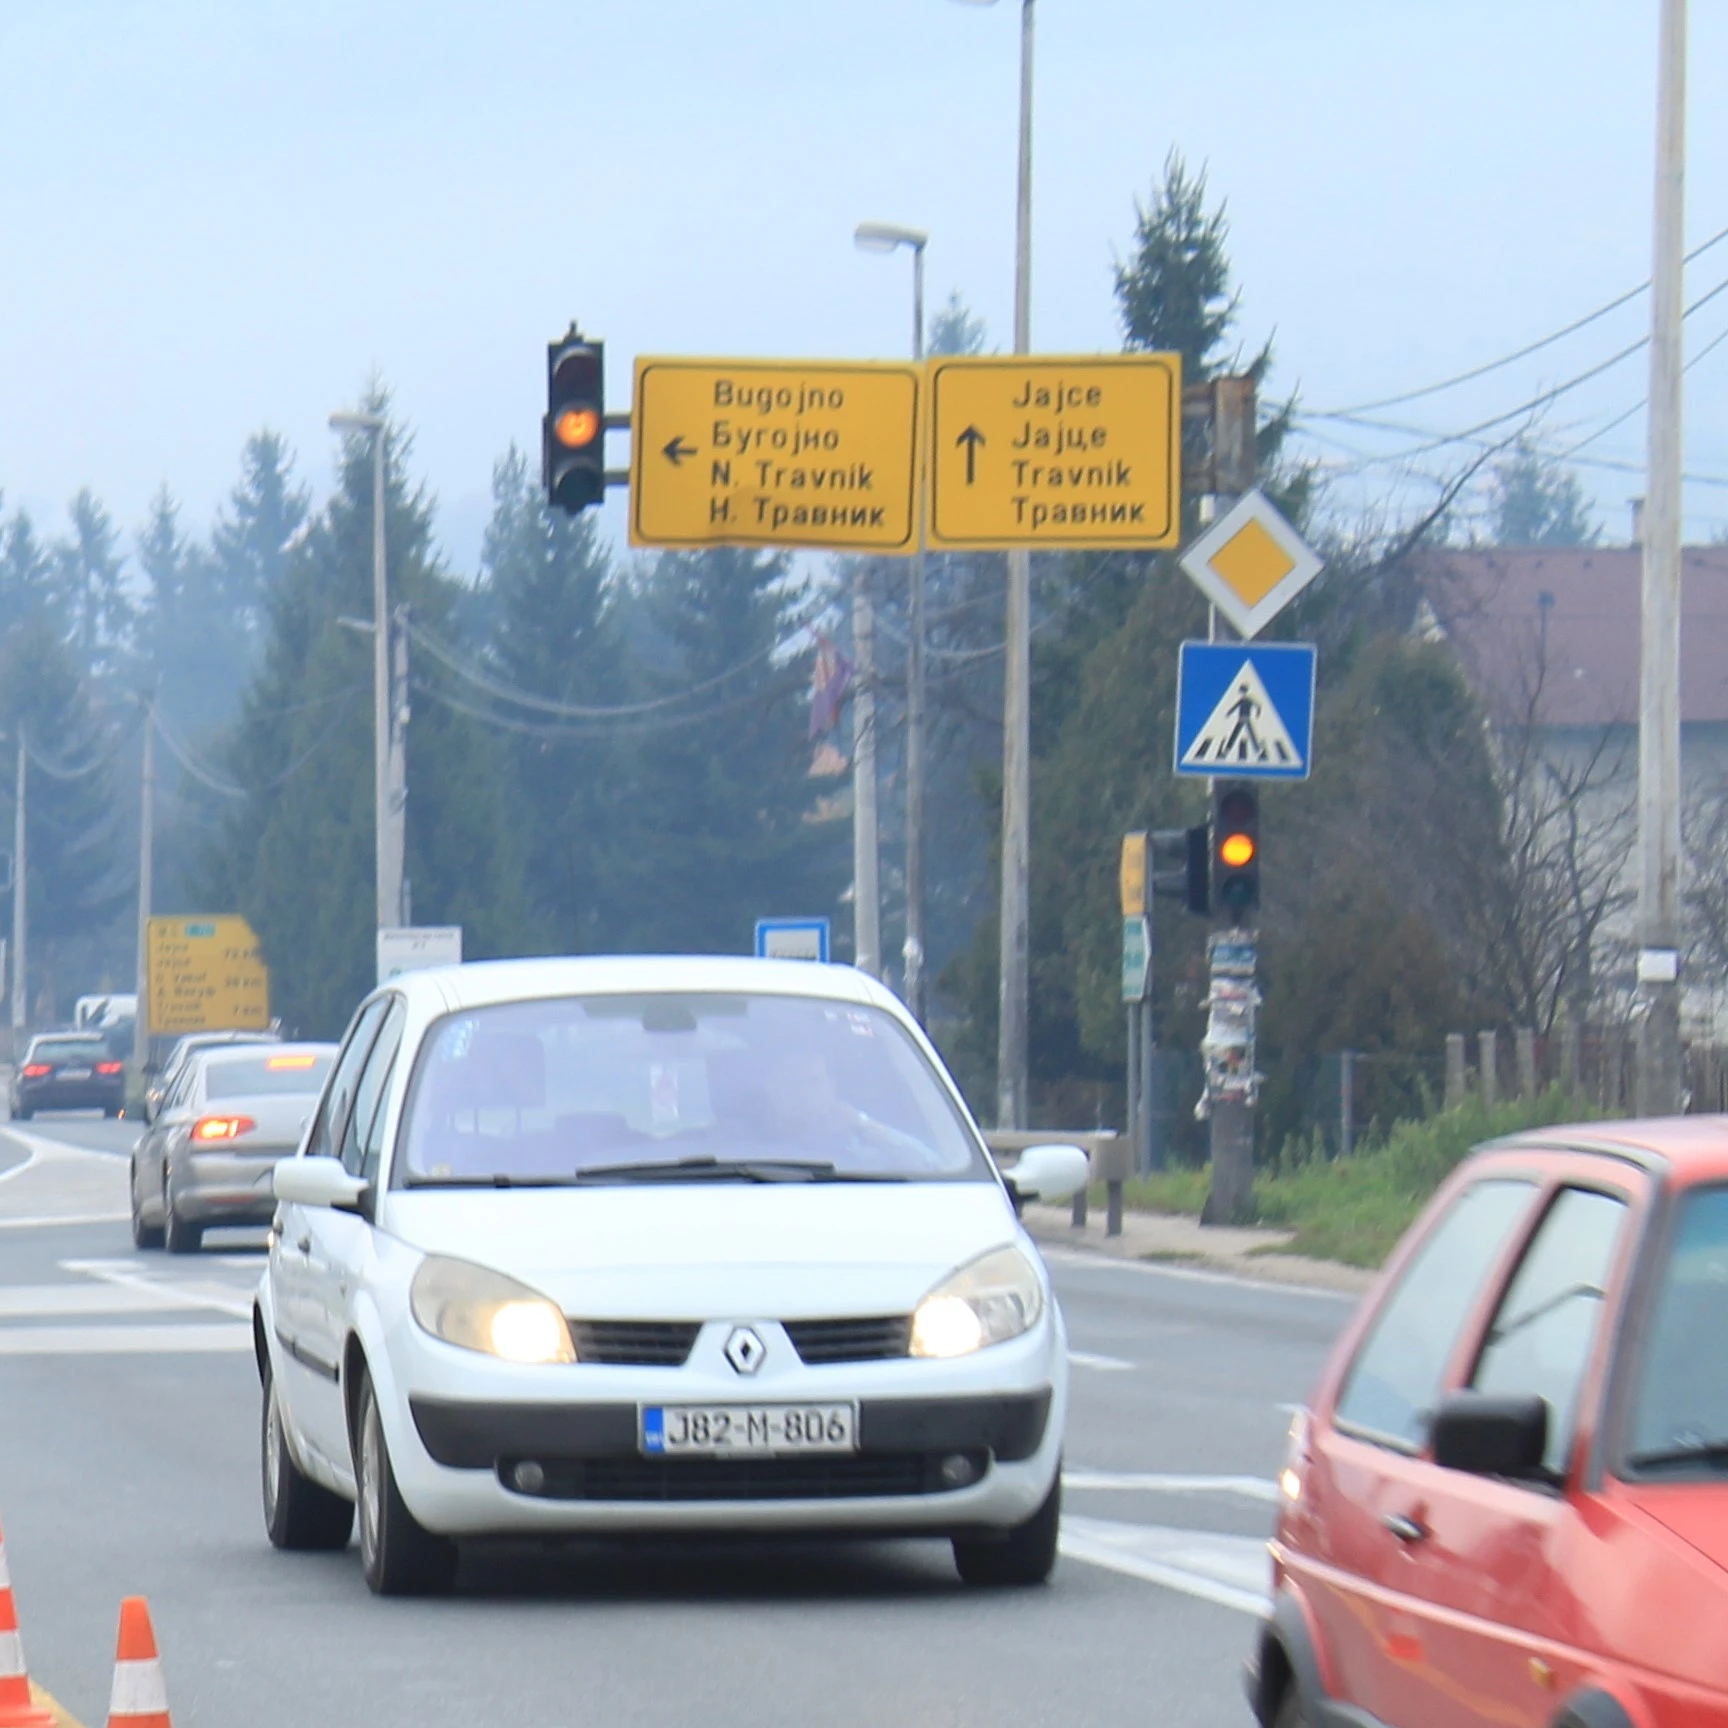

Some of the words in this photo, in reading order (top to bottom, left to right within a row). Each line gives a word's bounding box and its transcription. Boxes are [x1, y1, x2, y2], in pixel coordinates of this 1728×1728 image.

[713, 381, 844, 415] Bugojno
[1013, 381, 1102, 414] Jajce
[712, 422, 840, 455] Бугојно
[1012, 422, 1108, 456] Јајце
[711, 461, 740, 488] N.
[755, 461, 873, 490] Travnik
[1012, 461, 1131, 487] Travnik
[709, 497, 737, 524] Н.
[753, 498, 885, 531] Травник
[1012, 497, 1145, 530] Травник
[668, 1408, 847, 1446] J82-M-806
